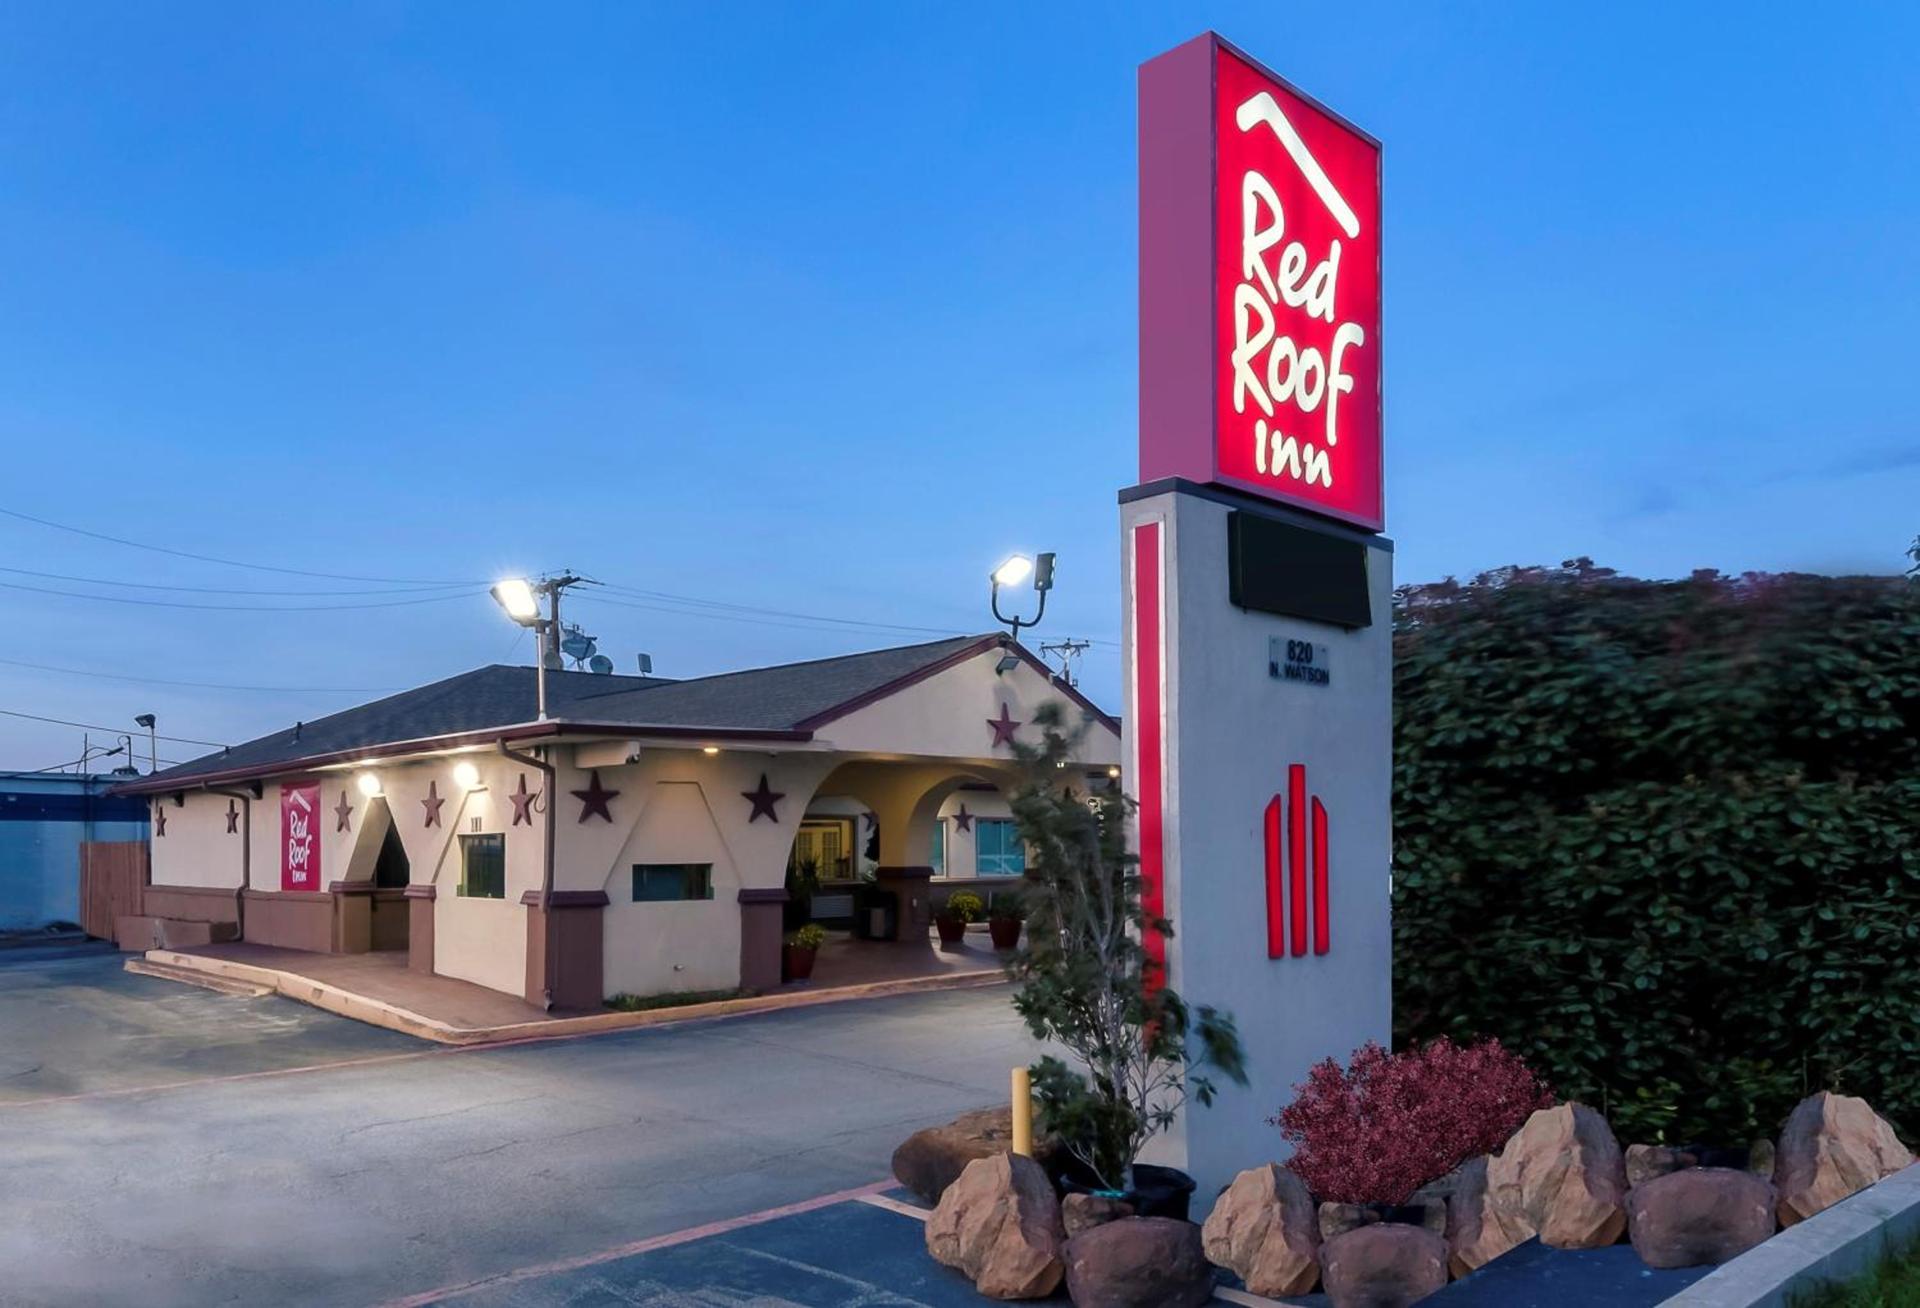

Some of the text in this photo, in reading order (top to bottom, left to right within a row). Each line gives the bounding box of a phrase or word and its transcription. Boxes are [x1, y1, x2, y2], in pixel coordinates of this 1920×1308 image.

[1242, 170, 1342, 323] Red
[1231, 283, 1364, 446] Roof
[1255, 419, 1332, 488] Inn
[1287, 639, 1313, 664] 820
[1284, 663, 1330, 685] WATSON
[290, 810, 308, 839] Red
[289, 834, 312, 870] Roof
